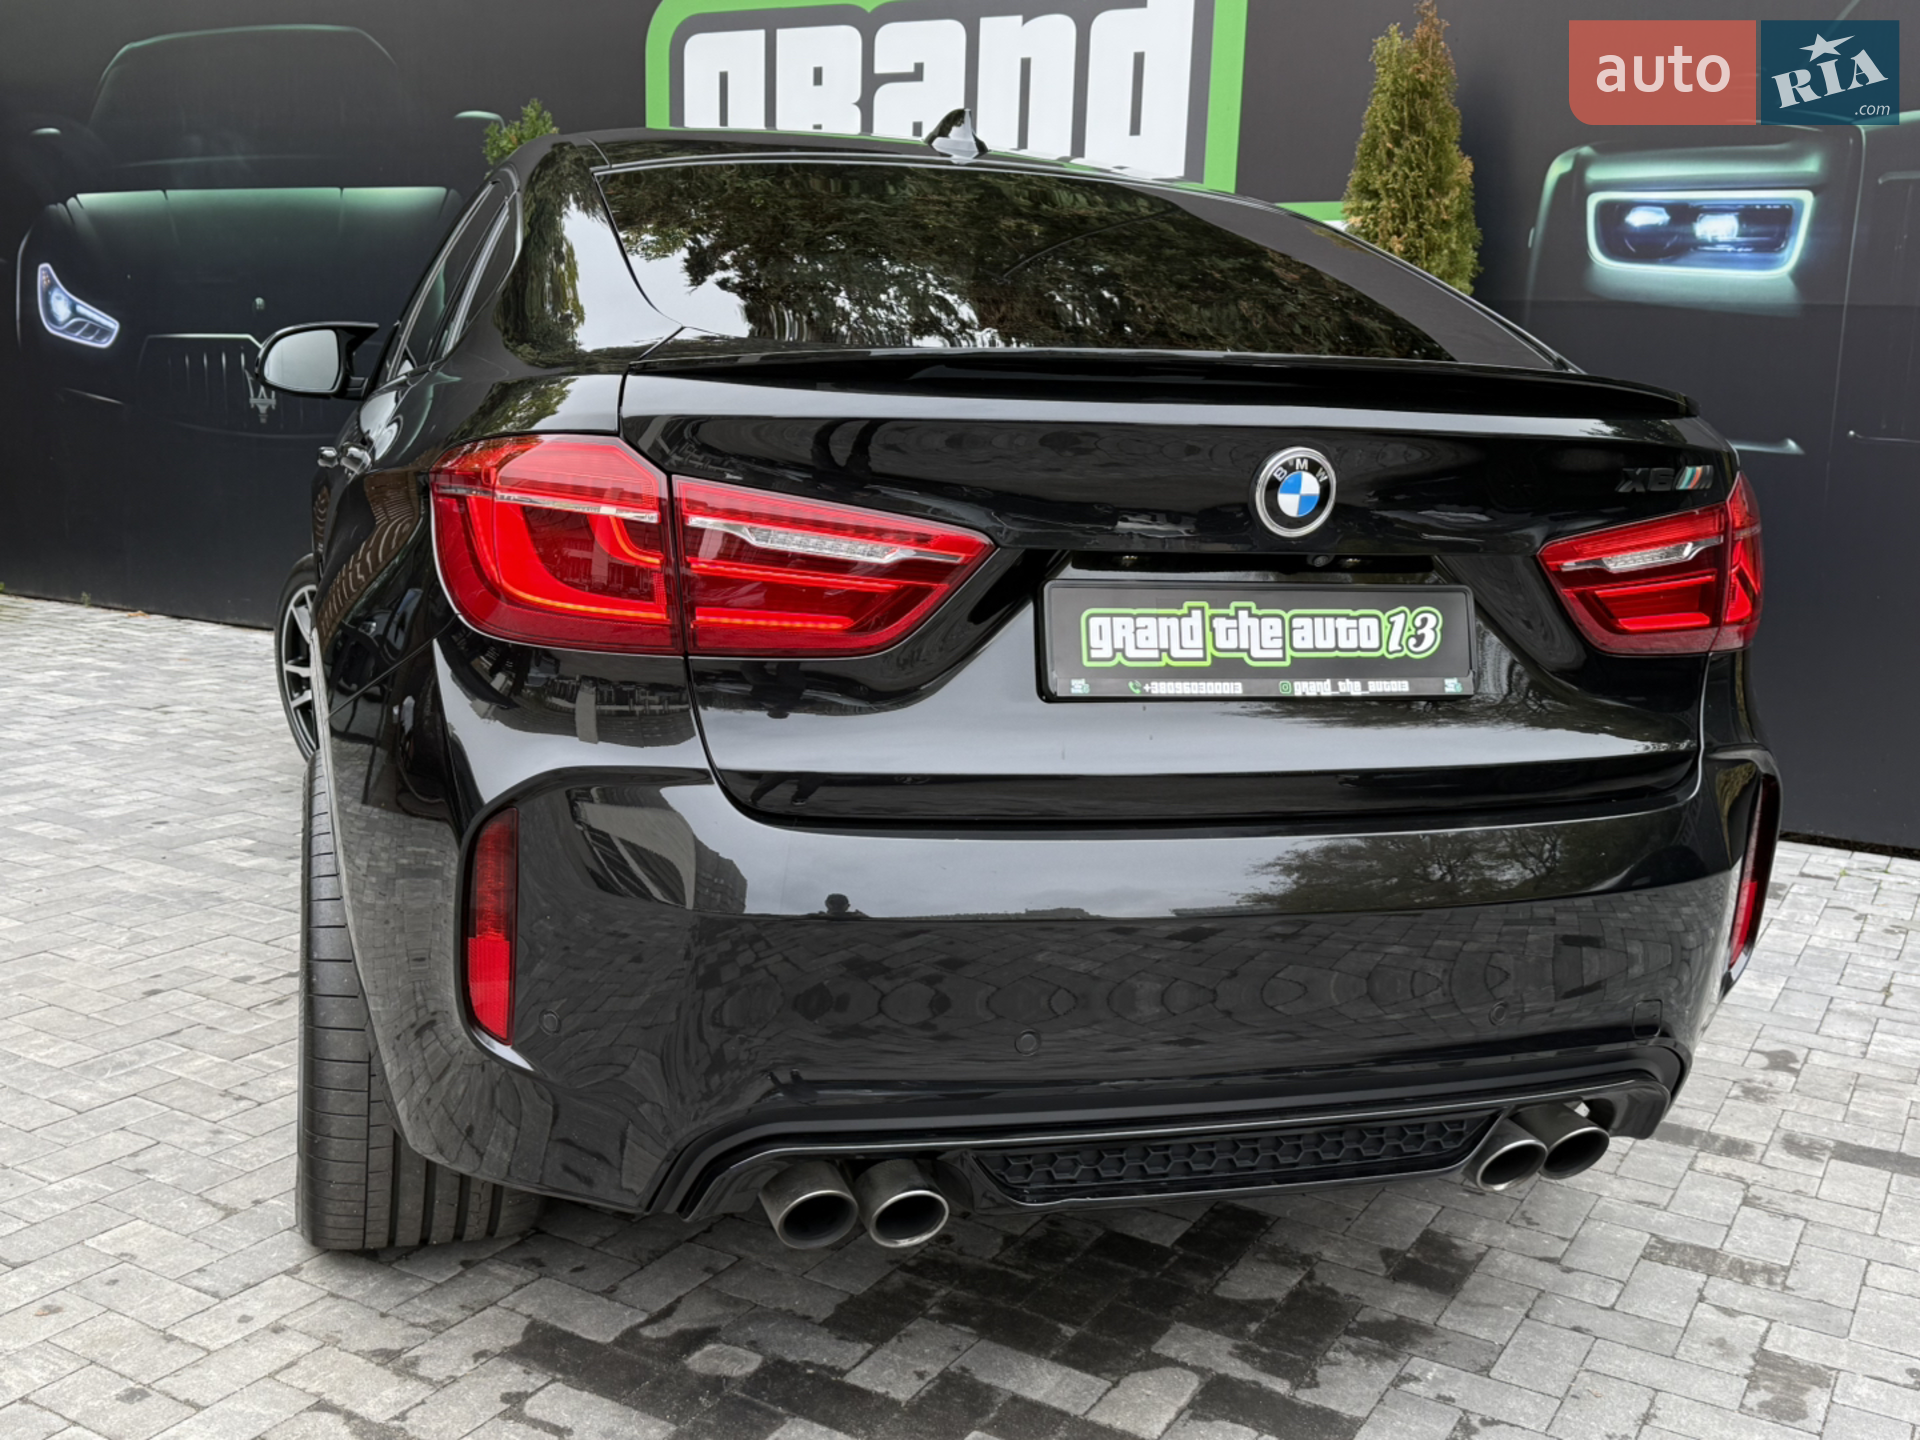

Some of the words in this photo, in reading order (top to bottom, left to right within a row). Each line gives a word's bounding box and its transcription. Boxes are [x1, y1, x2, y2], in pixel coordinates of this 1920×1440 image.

[1273, 458, 1328, 482] BMW
[1088, 609, 1205, 659] grand
[1212, 609, 1284, 659] the
